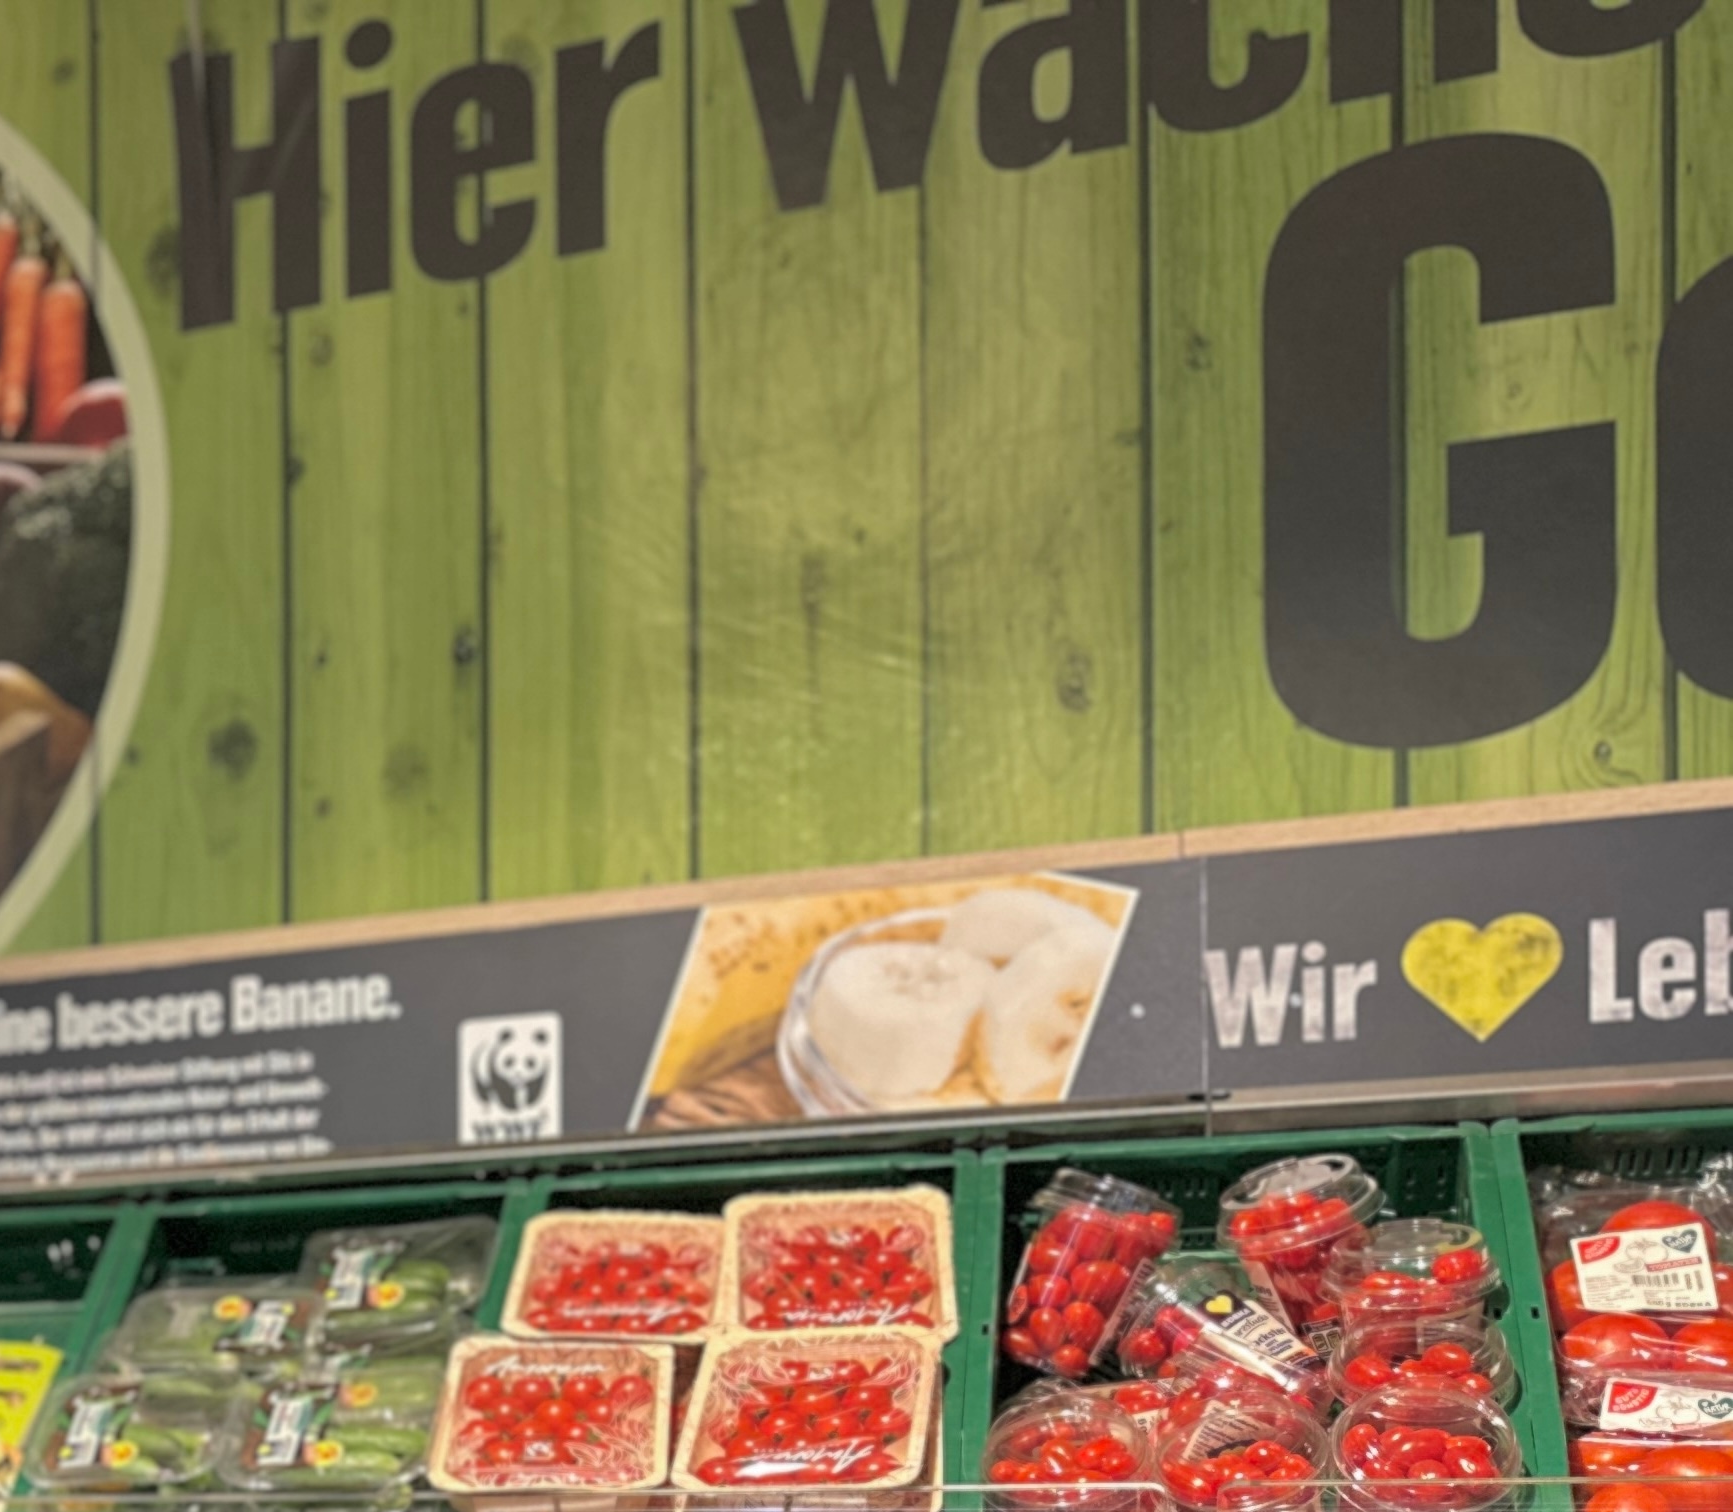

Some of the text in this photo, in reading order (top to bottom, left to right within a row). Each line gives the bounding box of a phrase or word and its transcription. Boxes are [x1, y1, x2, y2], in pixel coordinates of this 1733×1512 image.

[167, 19, 662, 331] Hier
[57, 992, 225, 1050] bessere
[231, 974, 403, 1036] Banane.
[1204, 941, 1377, 1048] Wir
[472, 1117, 542, 1142] WWF
